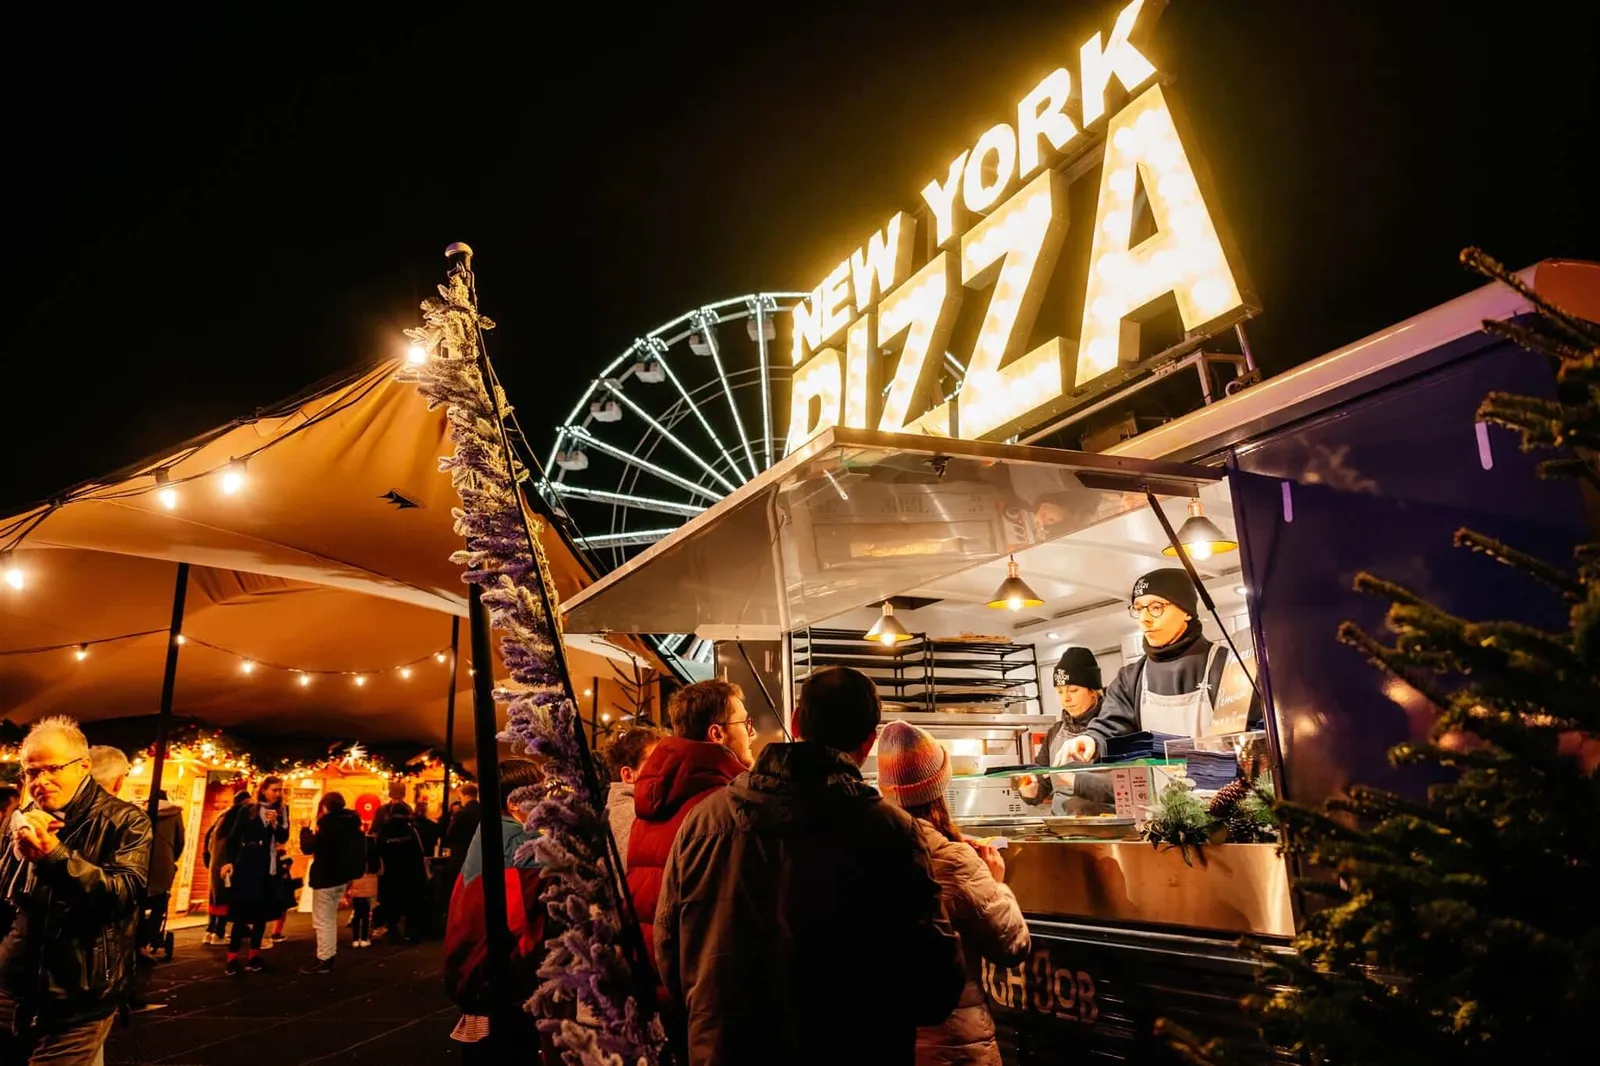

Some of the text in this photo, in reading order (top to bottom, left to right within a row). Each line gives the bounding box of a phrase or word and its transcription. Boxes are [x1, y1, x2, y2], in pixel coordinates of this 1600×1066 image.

[785, 83, 1246, 458] PIZZA
[792, 0, 1158, 365] NEW YORK
